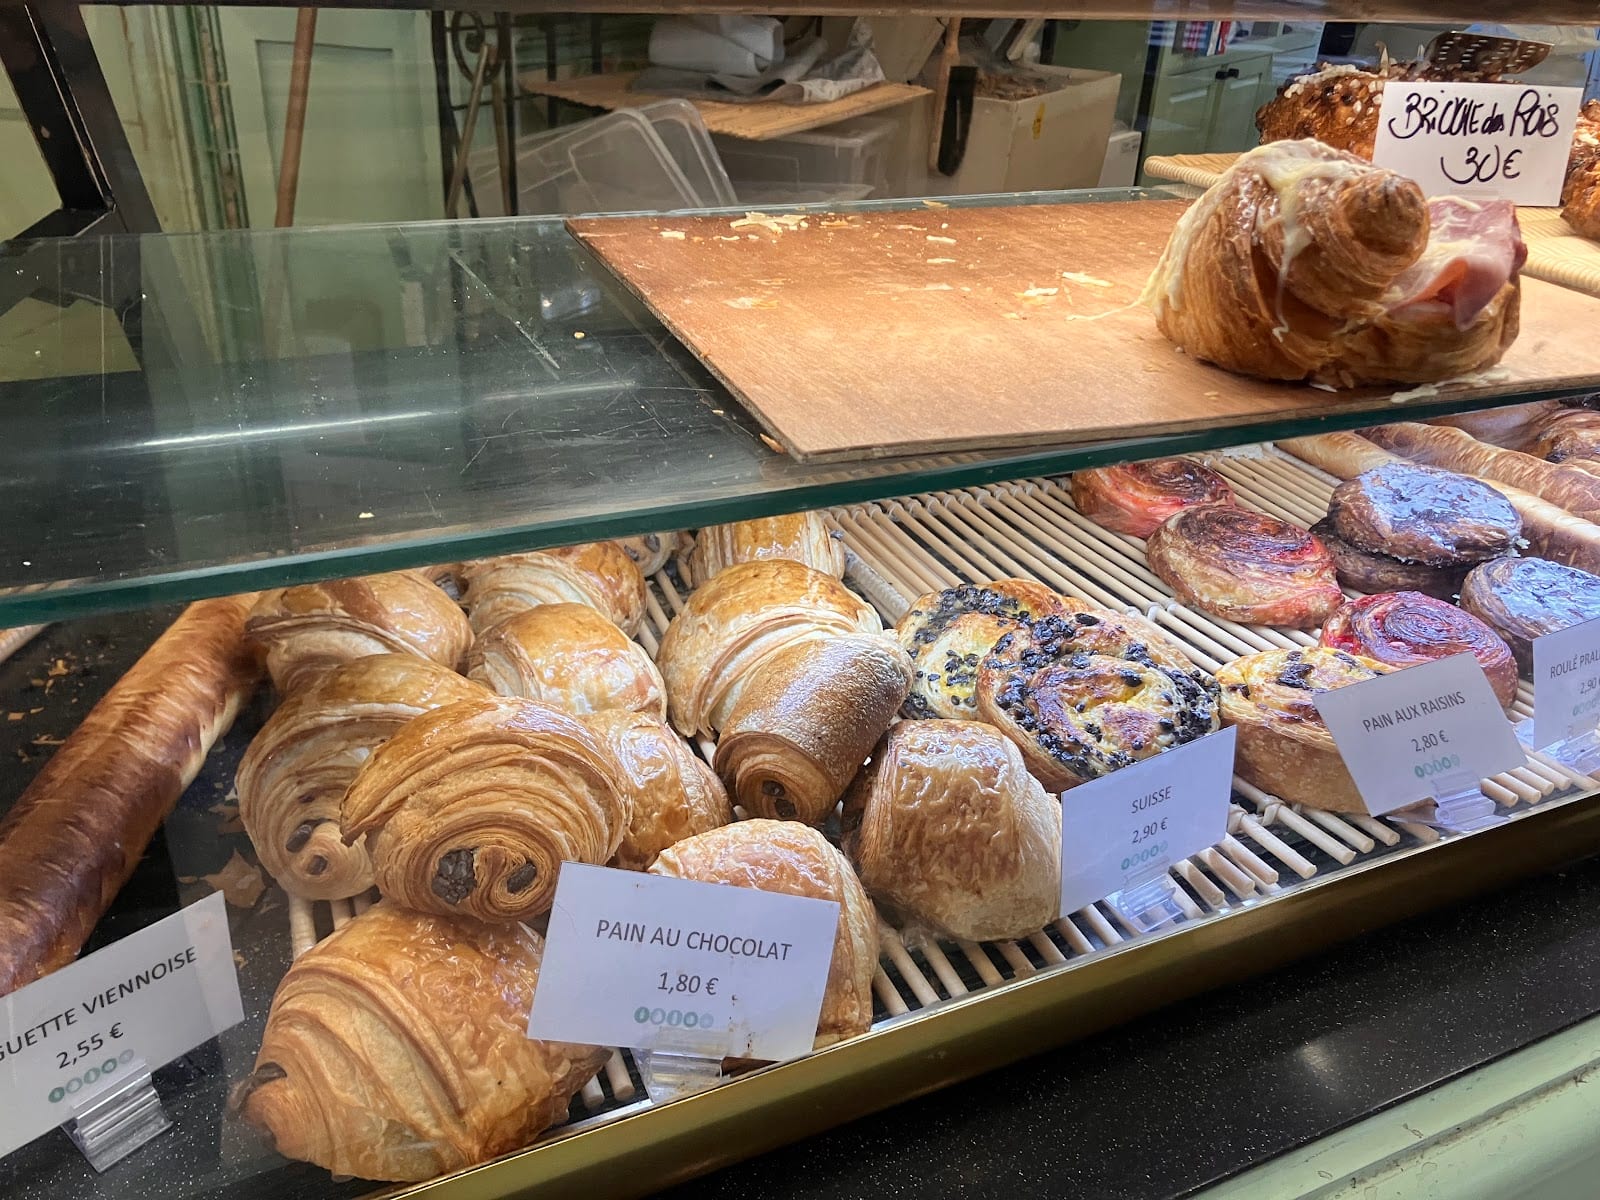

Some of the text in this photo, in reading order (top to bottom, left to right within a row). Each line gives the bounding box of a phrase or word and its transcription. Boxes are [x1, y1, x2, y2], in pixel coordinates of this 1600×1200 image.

[1550, 654, 1577, 679] ROULÉ
[1362, 691, 1466, 732] PAIN AUX RAISINS
[1411, 729, 1449, 753] 2,80 €
[1131, 785, 1172, 814] SUISSE
[1131, 817, 1168, 843] 2,90 €
[596, 919, 792, 961] PAIN AU CHOCOLAT
[82, 946, 197, 1015] VIENNOISE
[657, 972, 719, 995] 1,80 €
[56, 1022, 124, 1069] 2,55 €
